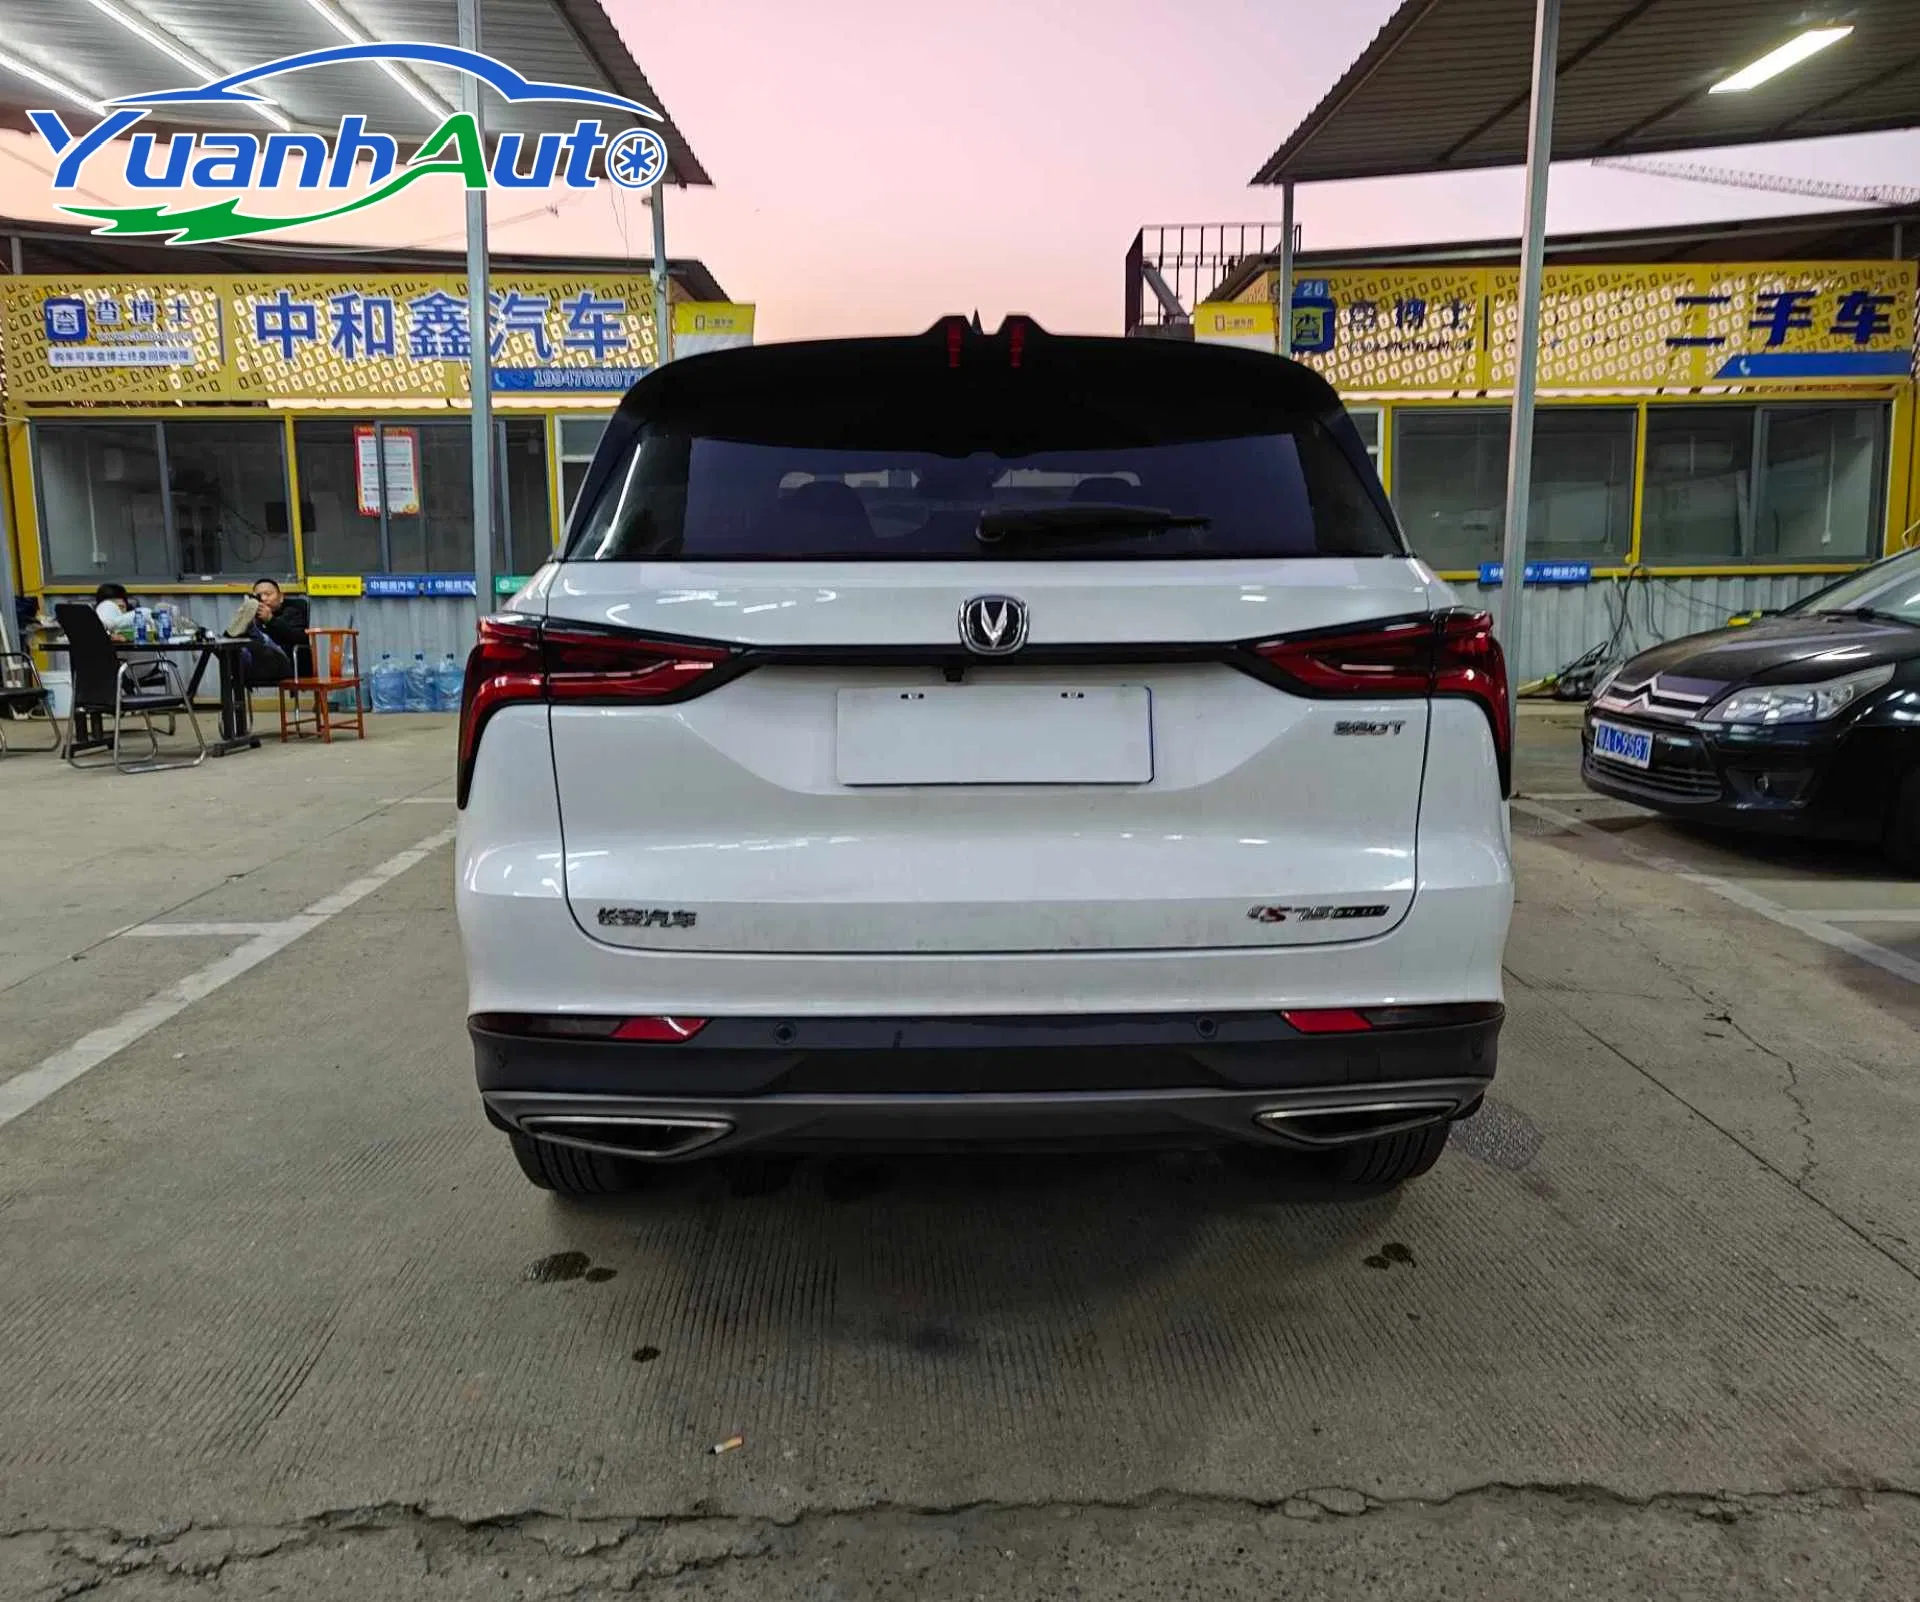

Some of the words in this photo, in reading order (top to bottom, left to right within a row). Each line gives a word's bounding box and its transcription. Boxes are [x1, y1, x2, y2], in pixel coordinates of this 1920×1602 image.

[94, 299, 191, 325] 查博士
[254, 290, 629, 361] 中和鑫汽车
[1664, 288, 1897, 348] 二手车
